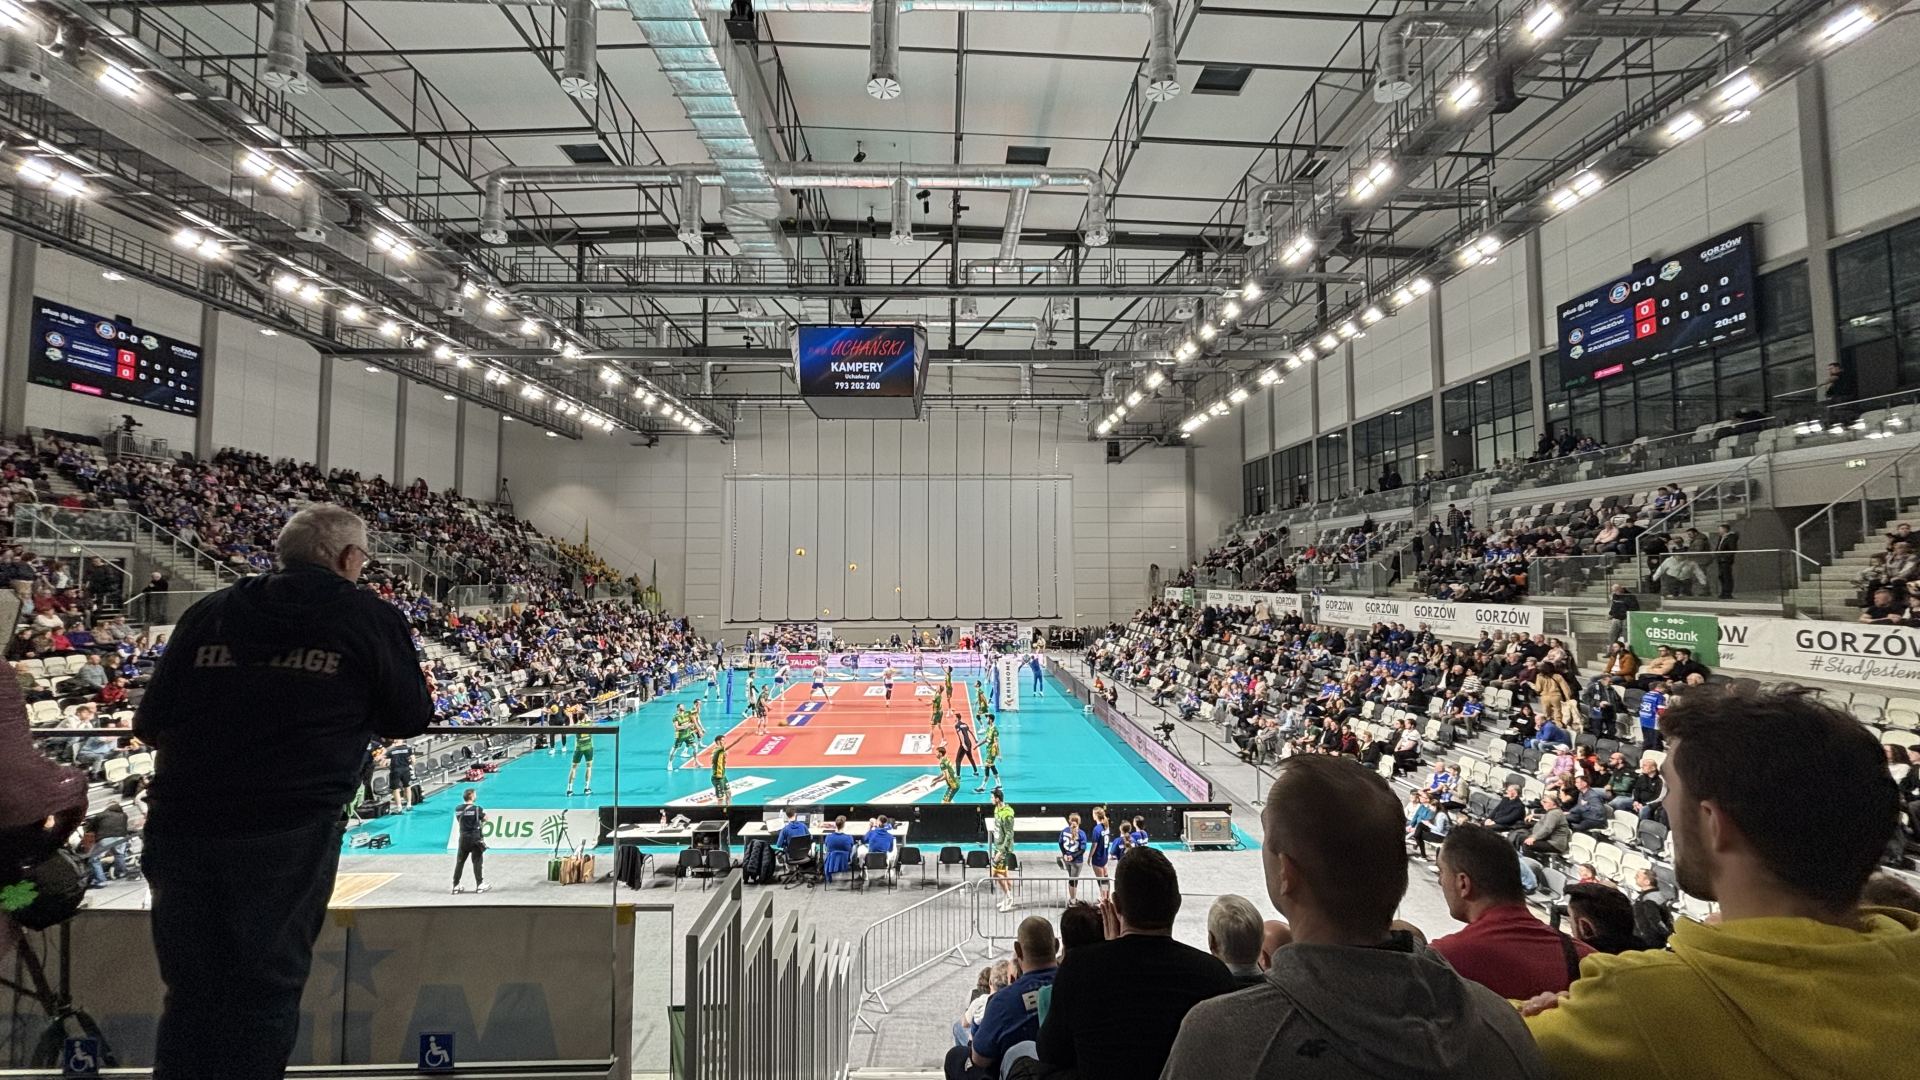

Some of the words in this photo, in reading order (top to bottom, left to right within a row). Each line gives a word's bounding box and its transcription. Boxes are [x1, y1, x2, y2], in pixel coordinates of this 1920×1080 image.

[1700, 236, 1742, 259] GORZÓW
[1640, 305, 1650, 315] 0
[1641, 323, 1650, 334] 0
[831, 335, 905, 356] UCHAŃSKI
[831, 362, 884, 372] KAMPERY
[835, 382, 849, 390] 793
[850, 382, 865, 390] 202
[866, 382, 881, 390] 200
[1365, 601, 1399, 614] GORZÓW
[1414, 603, 1456, 619] GORZÓW
[1475, 608, 1530, 625] GORZÓW
[1645, 627, 1699, 642] GBSBank
